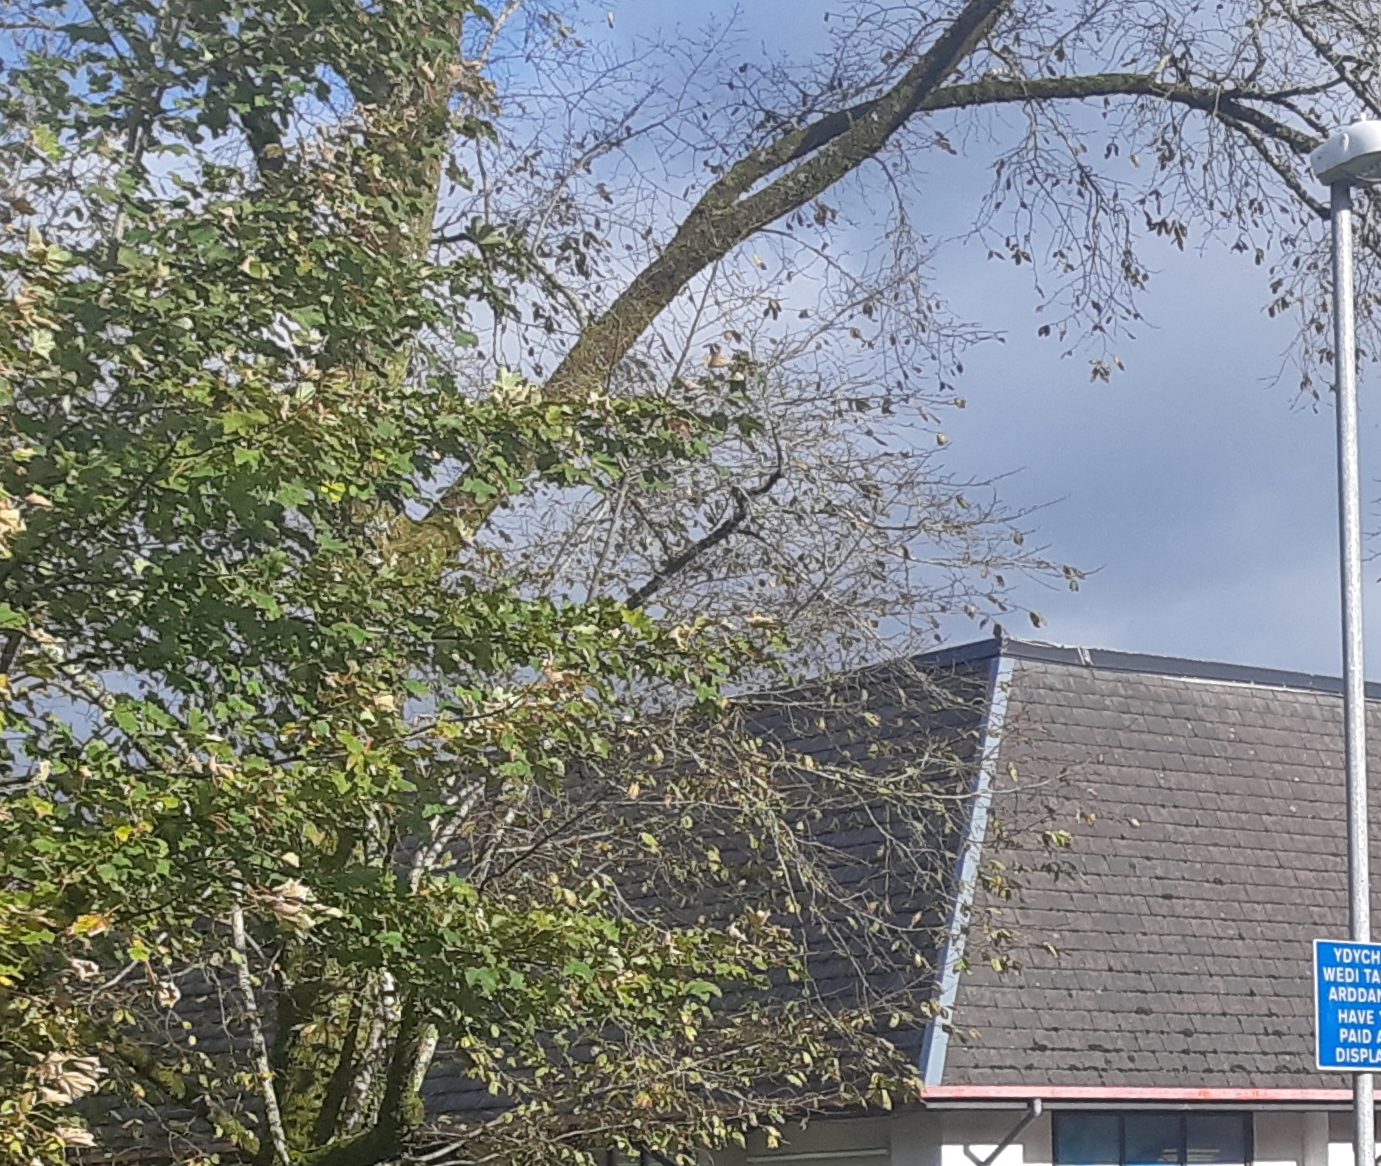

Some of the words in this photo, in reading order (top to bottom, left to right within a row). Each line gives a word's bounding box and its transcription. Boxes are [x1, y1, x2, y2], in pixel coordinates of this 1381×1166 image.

[1334, 948, 1380, 965] YDYCH
[1323, 967, 1359, 982] WEDI
[1338, 1009, 1374, 1024] HAVE
[1340, 1029, 1372, 1044] PAID
